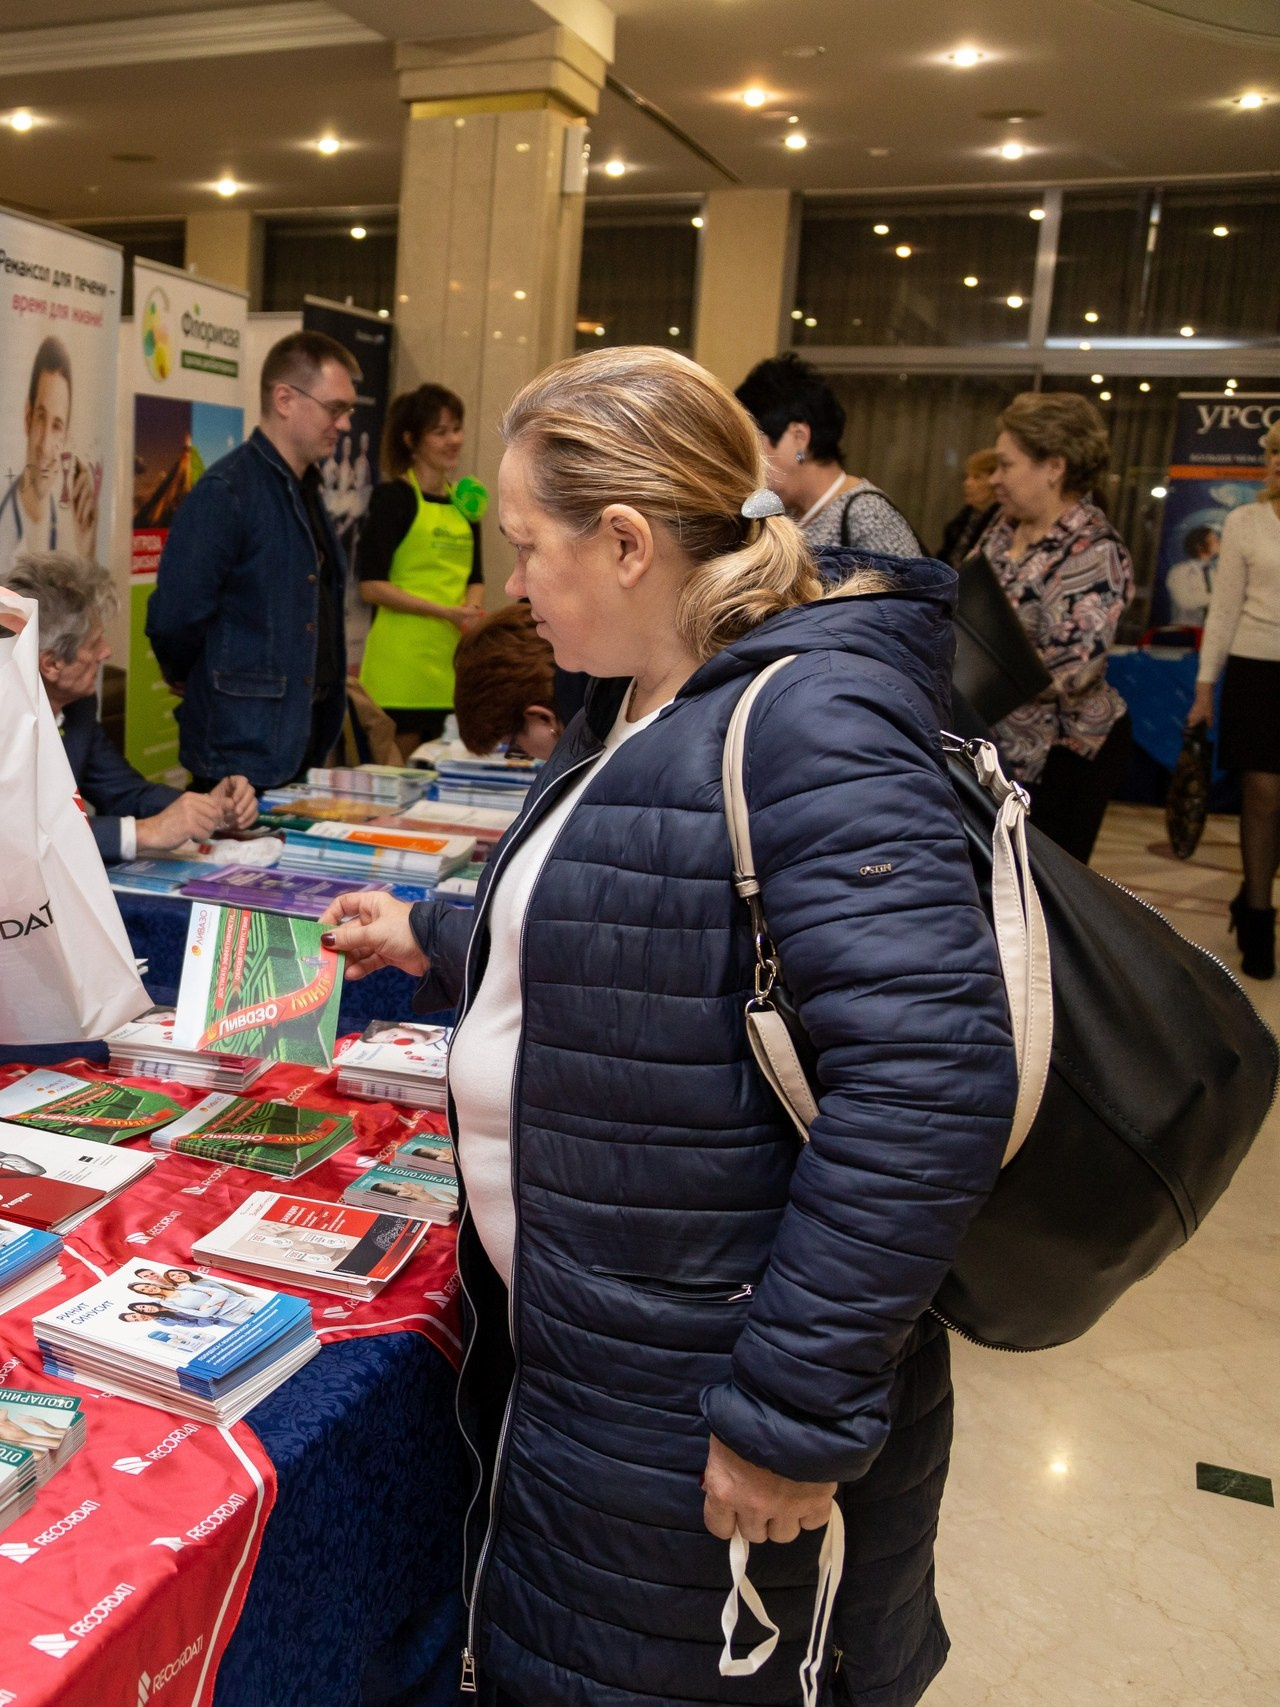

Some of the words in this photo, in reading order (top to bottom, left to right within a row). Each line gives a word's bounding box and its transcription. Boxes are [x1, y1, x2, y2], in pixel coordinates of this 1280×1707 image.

[51, 269, 72, 289] для
[11, 293, 48, 317] время
[49, 300, 69, 320] для
[197, 910, 208, 945] ЛИВАЗО
[238, 915, 249, 955] ПРЕПЯТСТВИЯ
[218, 964, 228, 999] ДОСТИГАТЬ
[234, 954, 244, 981] ОБХОДЯ
[56, 1301, 91, 1322] РИНИТ
[71, 1299, 114, 1326] СИНУСИТ
[148, 1422, 201, 1461] RECORDATI
[36, 1498, 102, 1547] RECORDATI
[188, 1493, 248, 1541] RECORDATI
[67, 1583, 137, 1639] RECORDATI
[151, 1635, 205, 1694] RECORDATI
